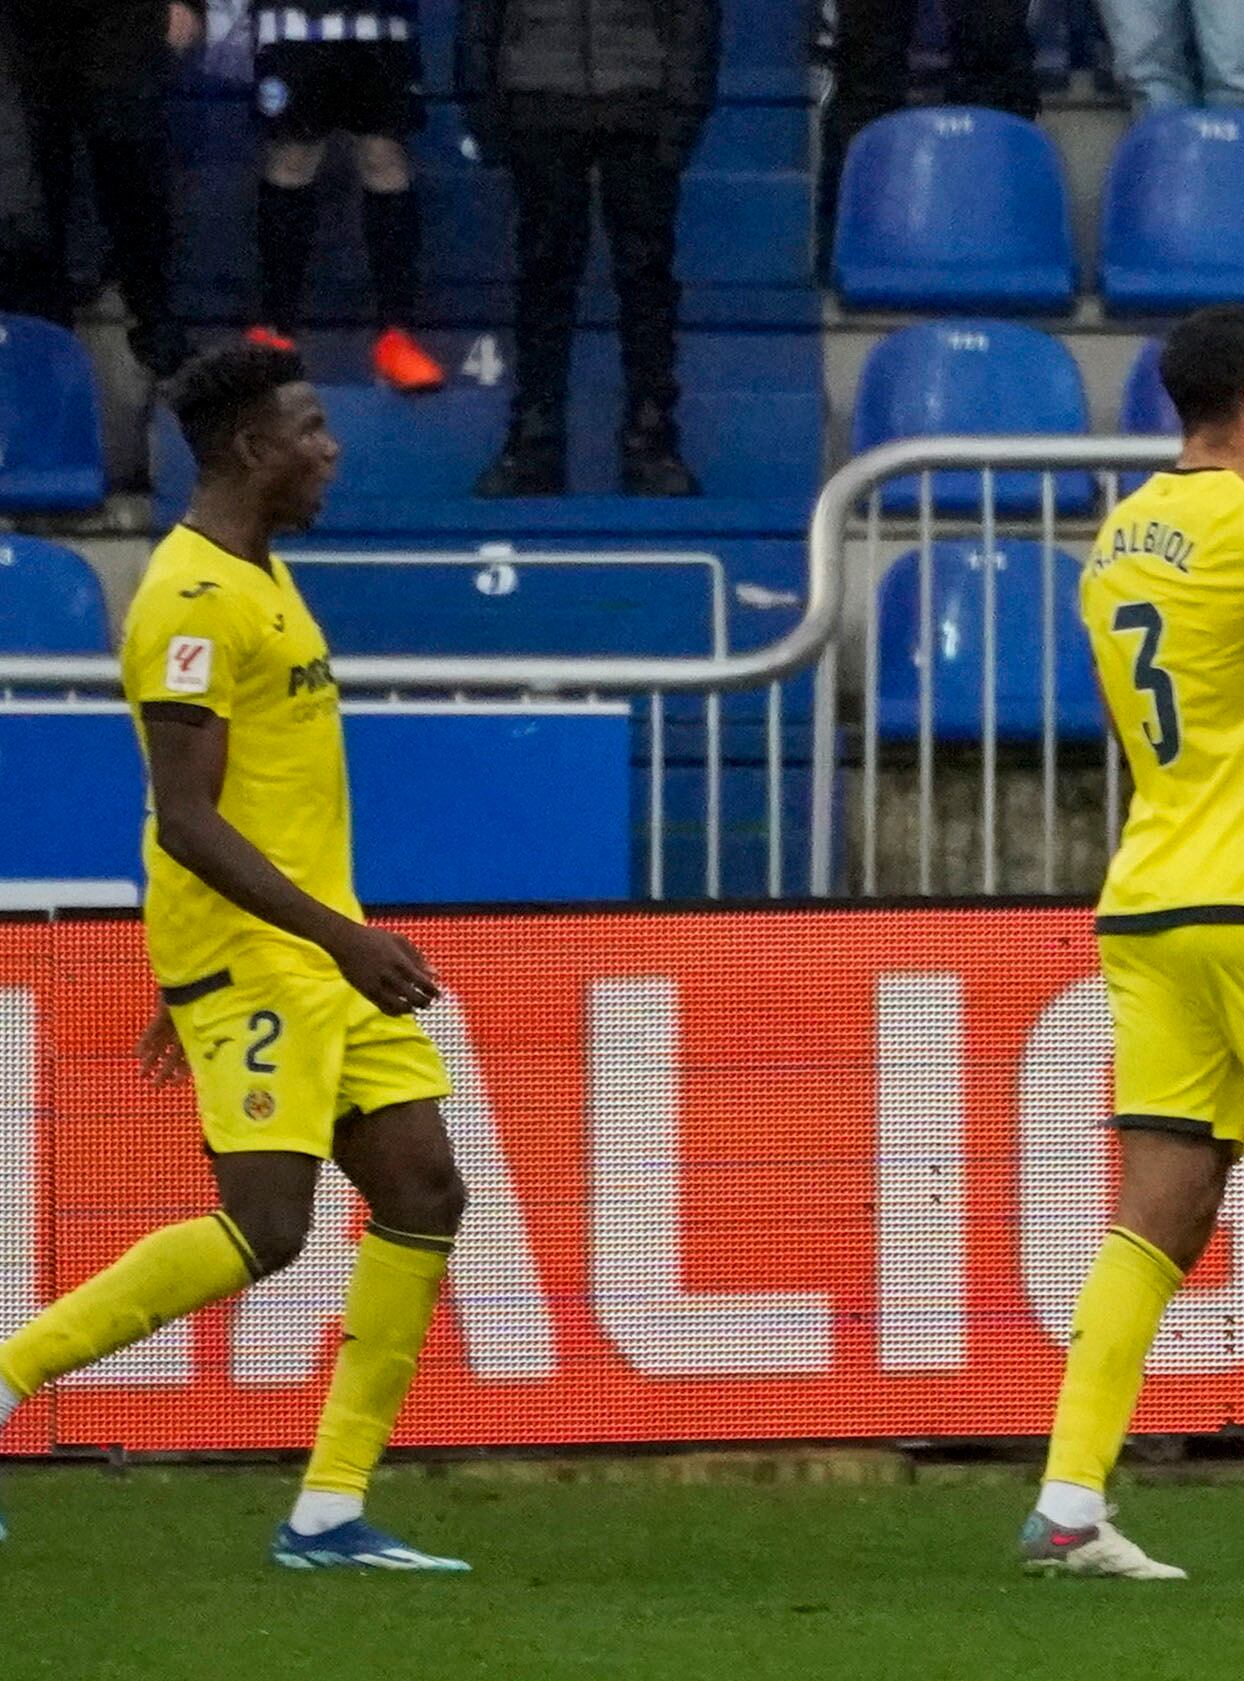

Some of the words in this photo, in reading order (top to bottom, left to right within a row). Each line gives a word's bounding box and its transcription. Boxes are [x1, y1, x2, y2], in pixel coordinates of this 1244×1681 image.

[461, 335, 502, 386] 4
[1113, 602, 1183, 769] 3
[244, 1010, 283, 1074] 2
